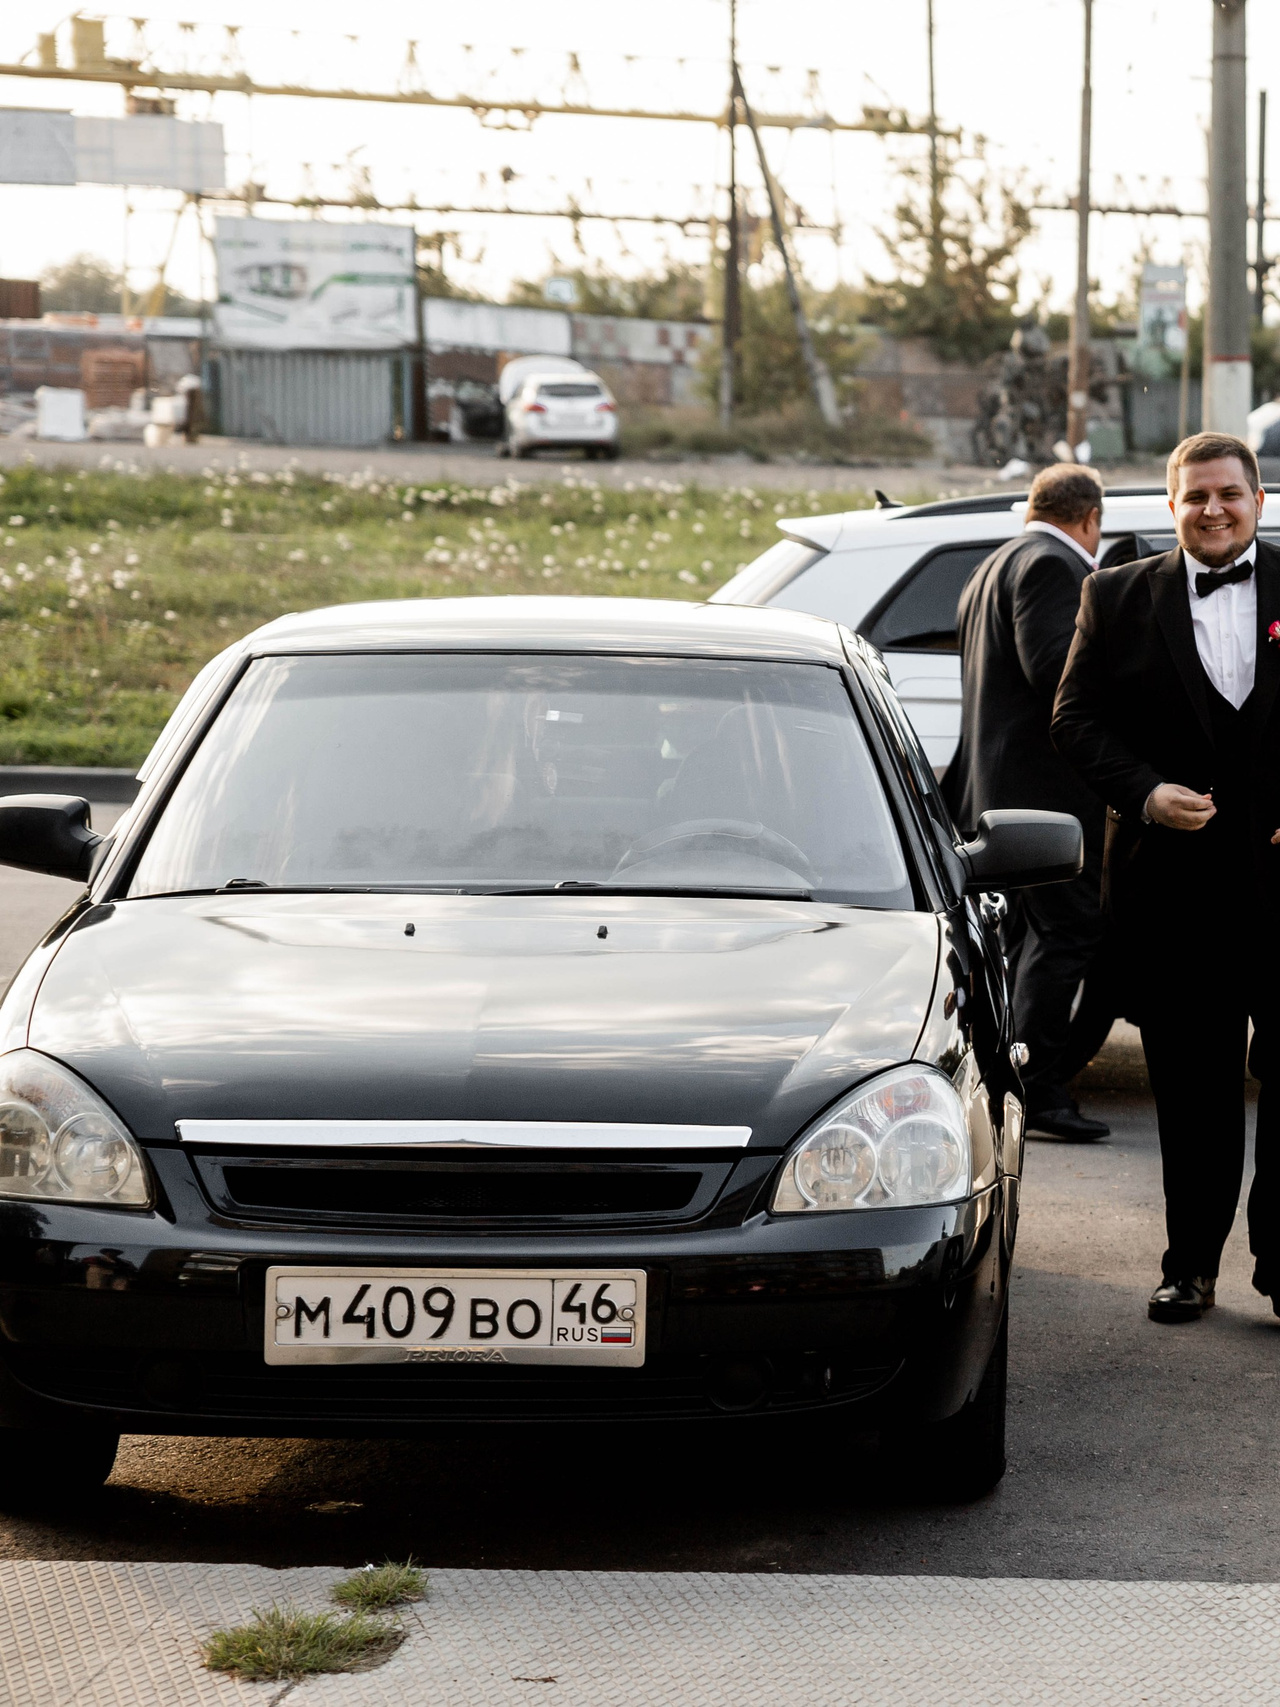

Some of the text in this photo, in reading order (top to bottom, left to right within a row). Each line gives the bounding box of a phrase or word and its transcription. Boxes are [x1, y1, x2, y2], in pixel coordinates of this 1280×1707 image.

[561, 1283, 617, 1325] 46
[556, 1326, 599, 1342] RUS
[404, 1347, 509, 1363] PRIORA
